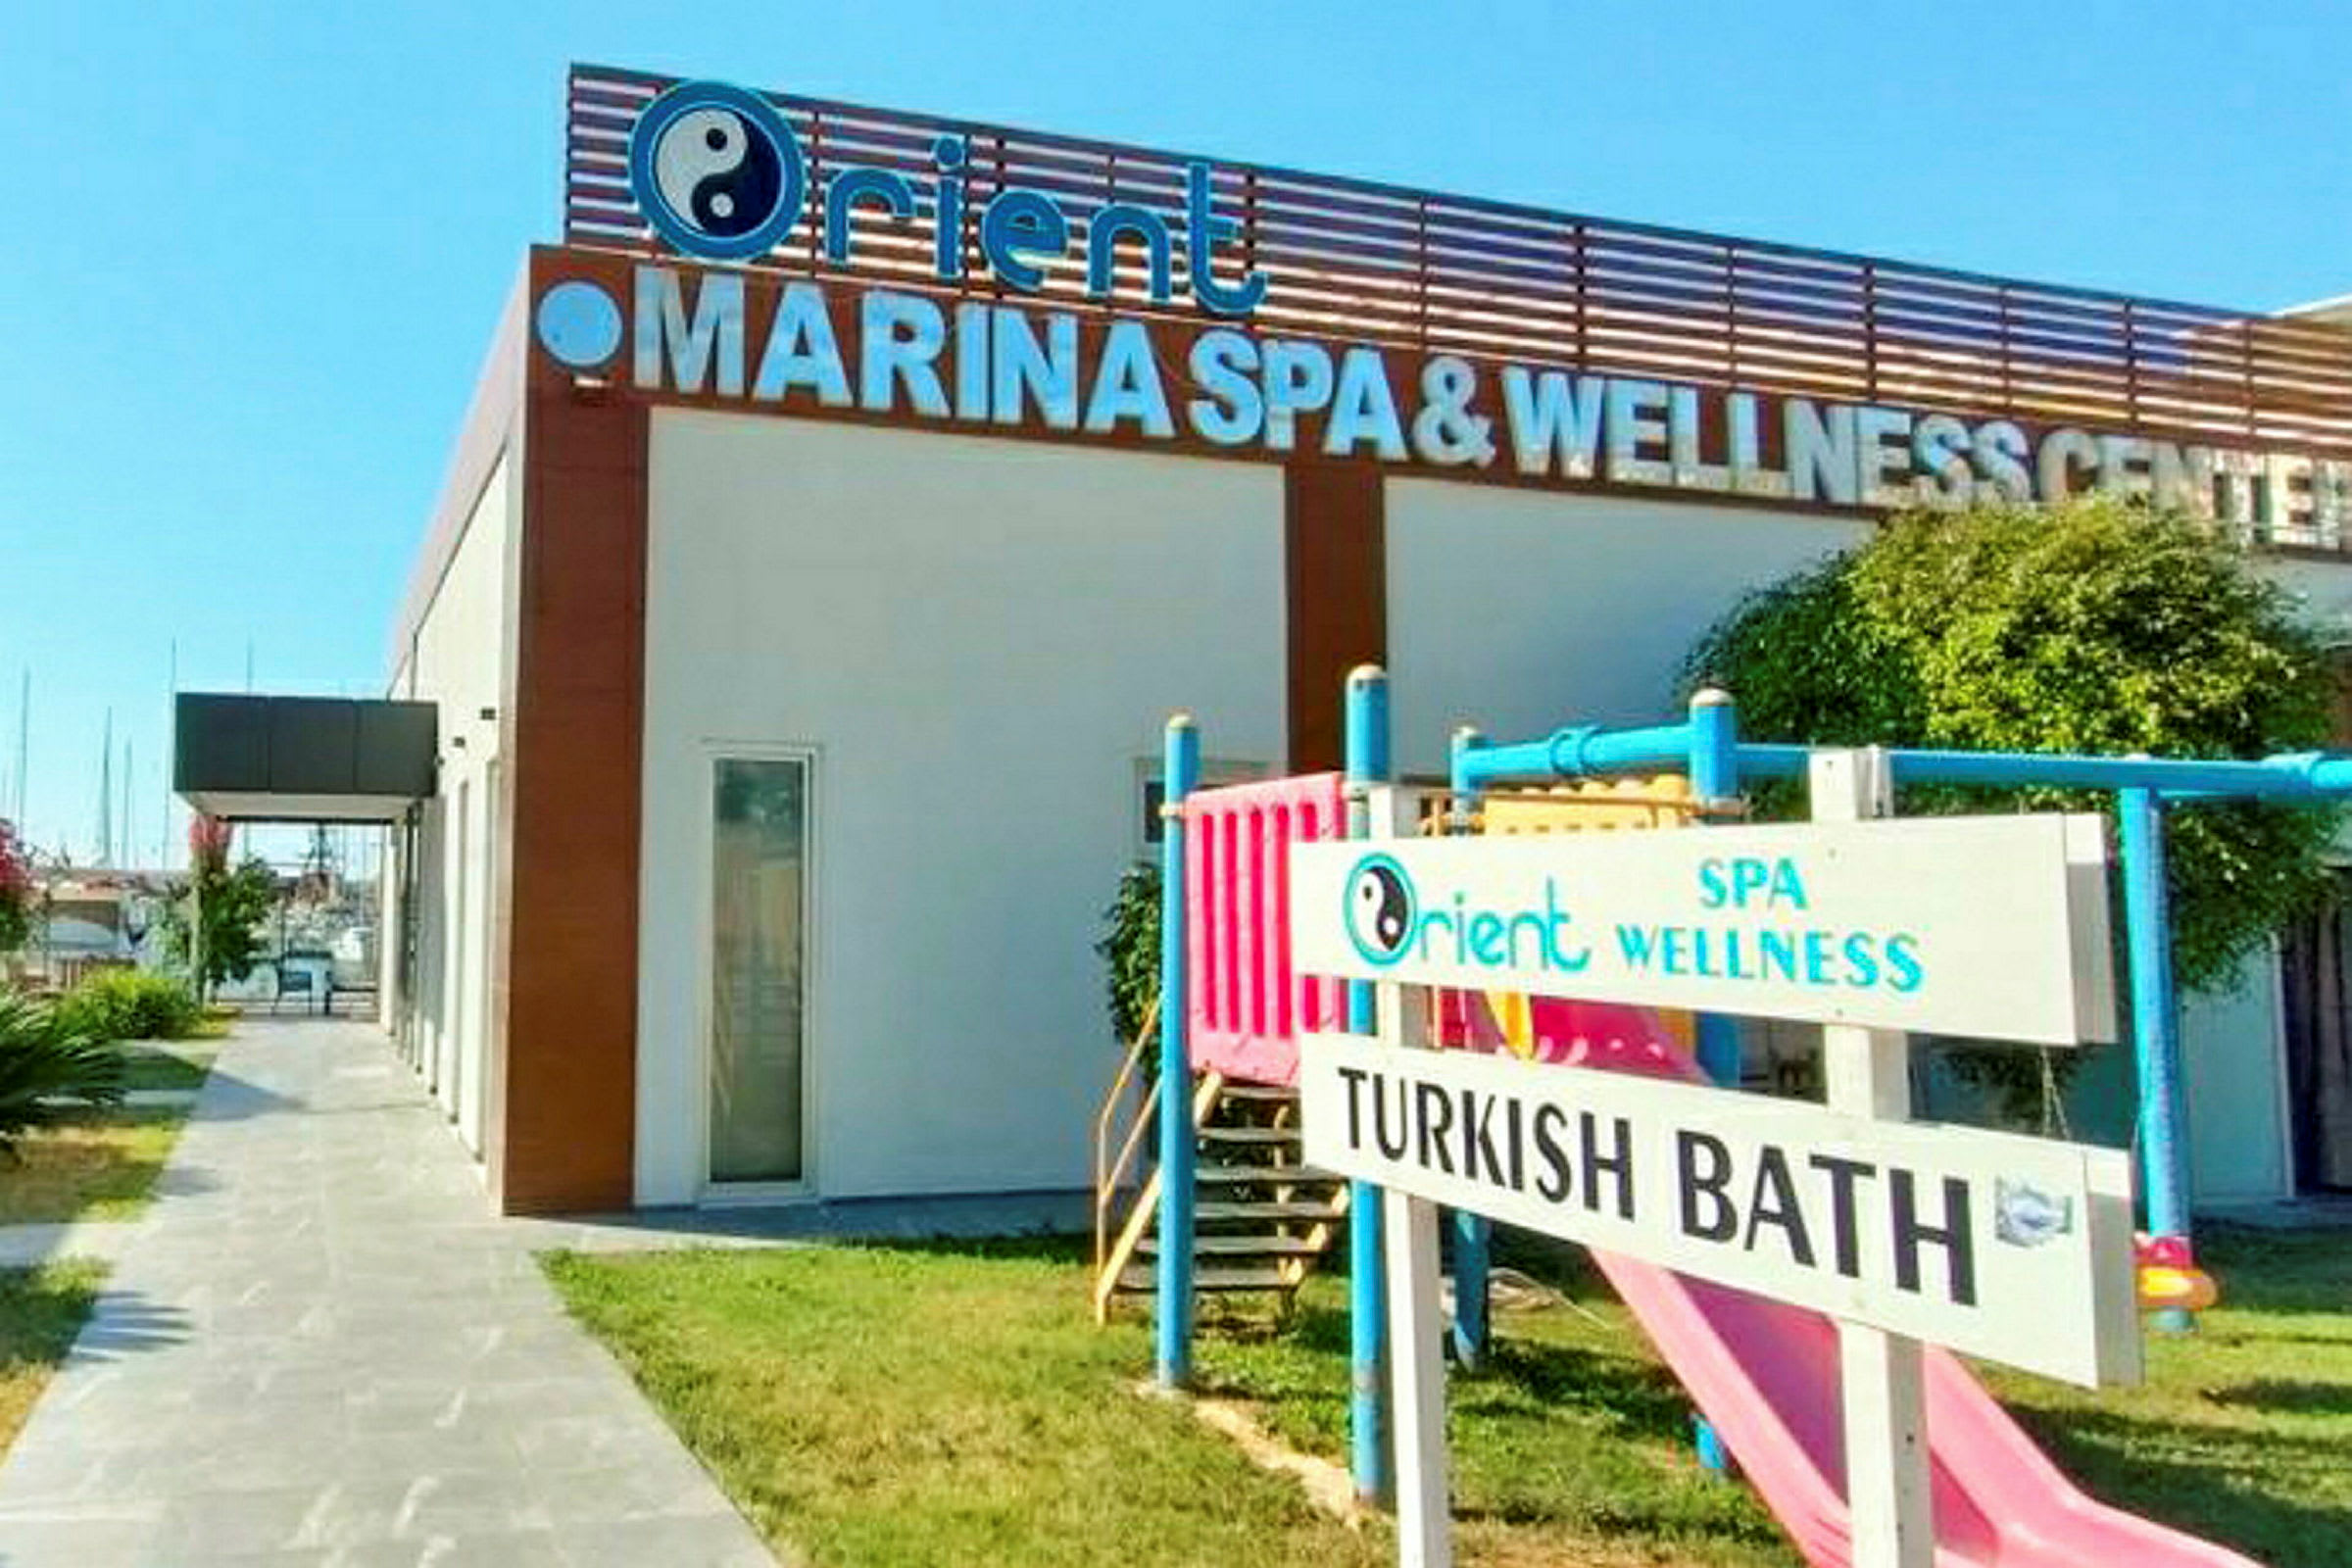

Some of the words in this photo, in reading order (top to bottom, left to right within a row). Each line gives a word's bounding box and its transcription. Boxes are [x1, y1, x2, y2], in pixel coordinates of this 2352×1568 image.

[629, 81, 1268, 316] Orient
[631, 265, 1176, 441] MARINA
[1187, 325, 1408, 463] SPA
[1411, 354, 1496, 468] &
[1499, 366, 2032, 508] WELLNESS
[1342, 851, 1591, 970] Orient
[1616, 923, 1925, 994] WELLNESS
[1697, 857, 1809, 911] SPA
[1336, 1066, 1637, 1223] TURKISH
[1675, 1129, 1979, 1308] BATH
